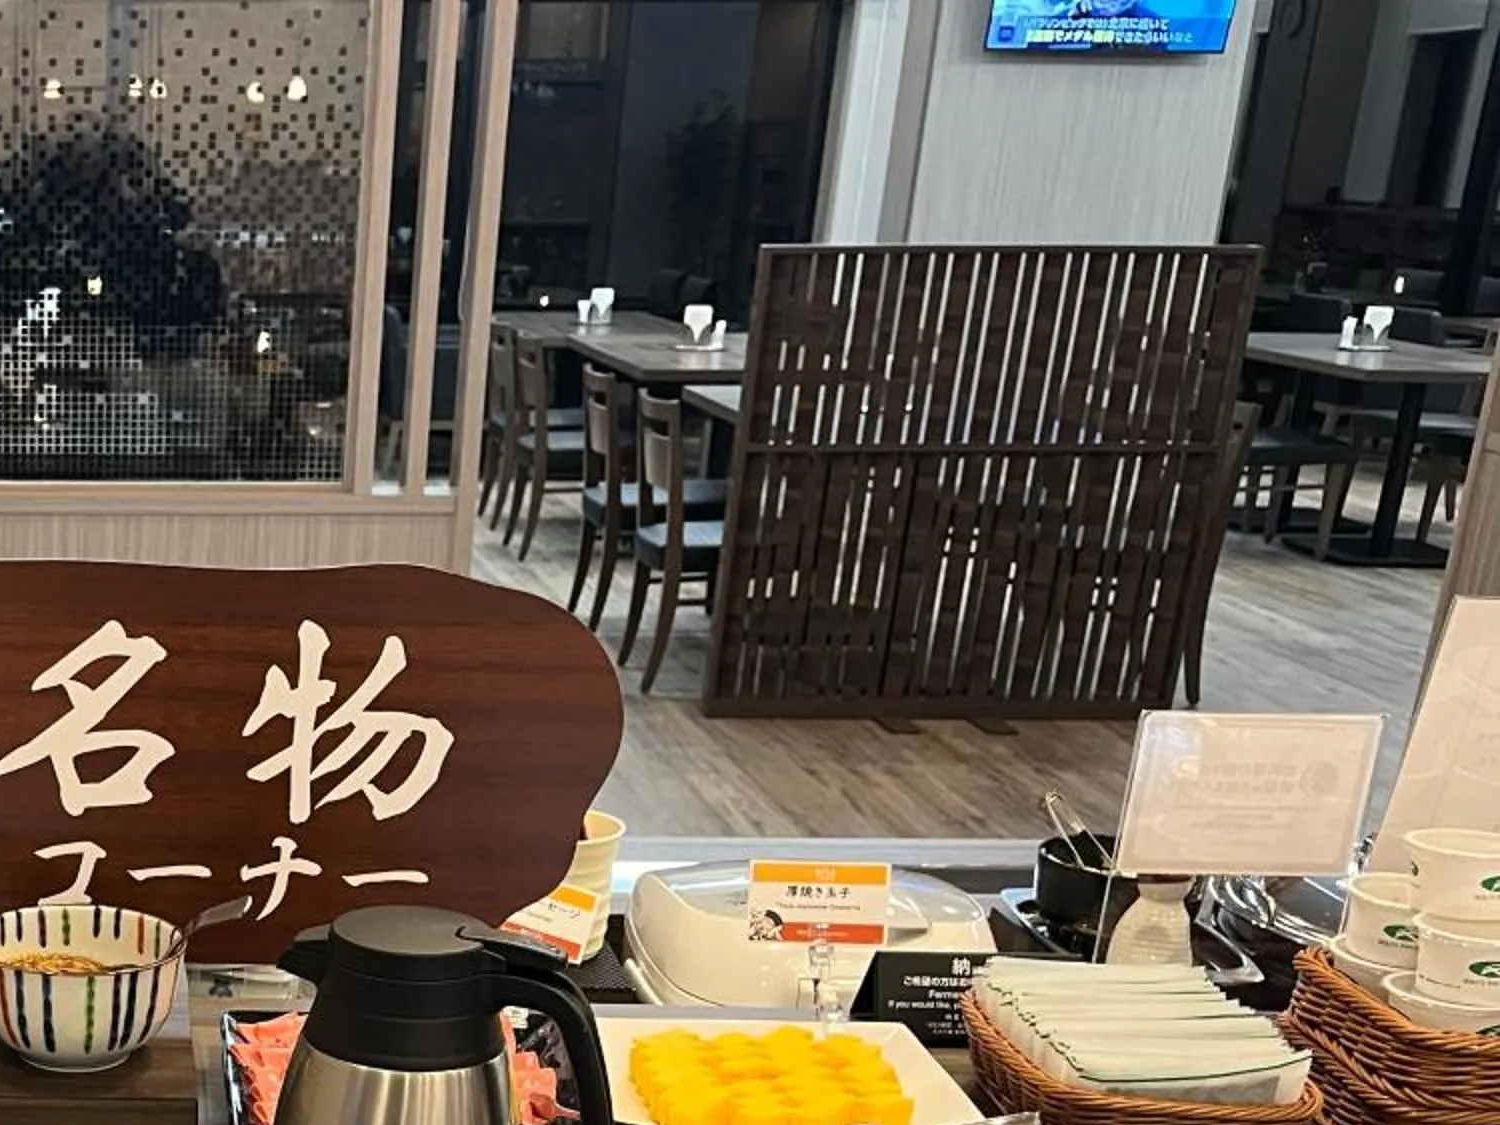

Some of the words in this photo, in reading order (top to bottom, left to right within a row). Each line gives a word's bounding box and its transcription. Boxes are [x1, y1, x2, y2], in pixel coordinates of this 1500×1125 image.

[32, 835, 430, 921] コーナー
[928, 989, 960, 999] Ferme
